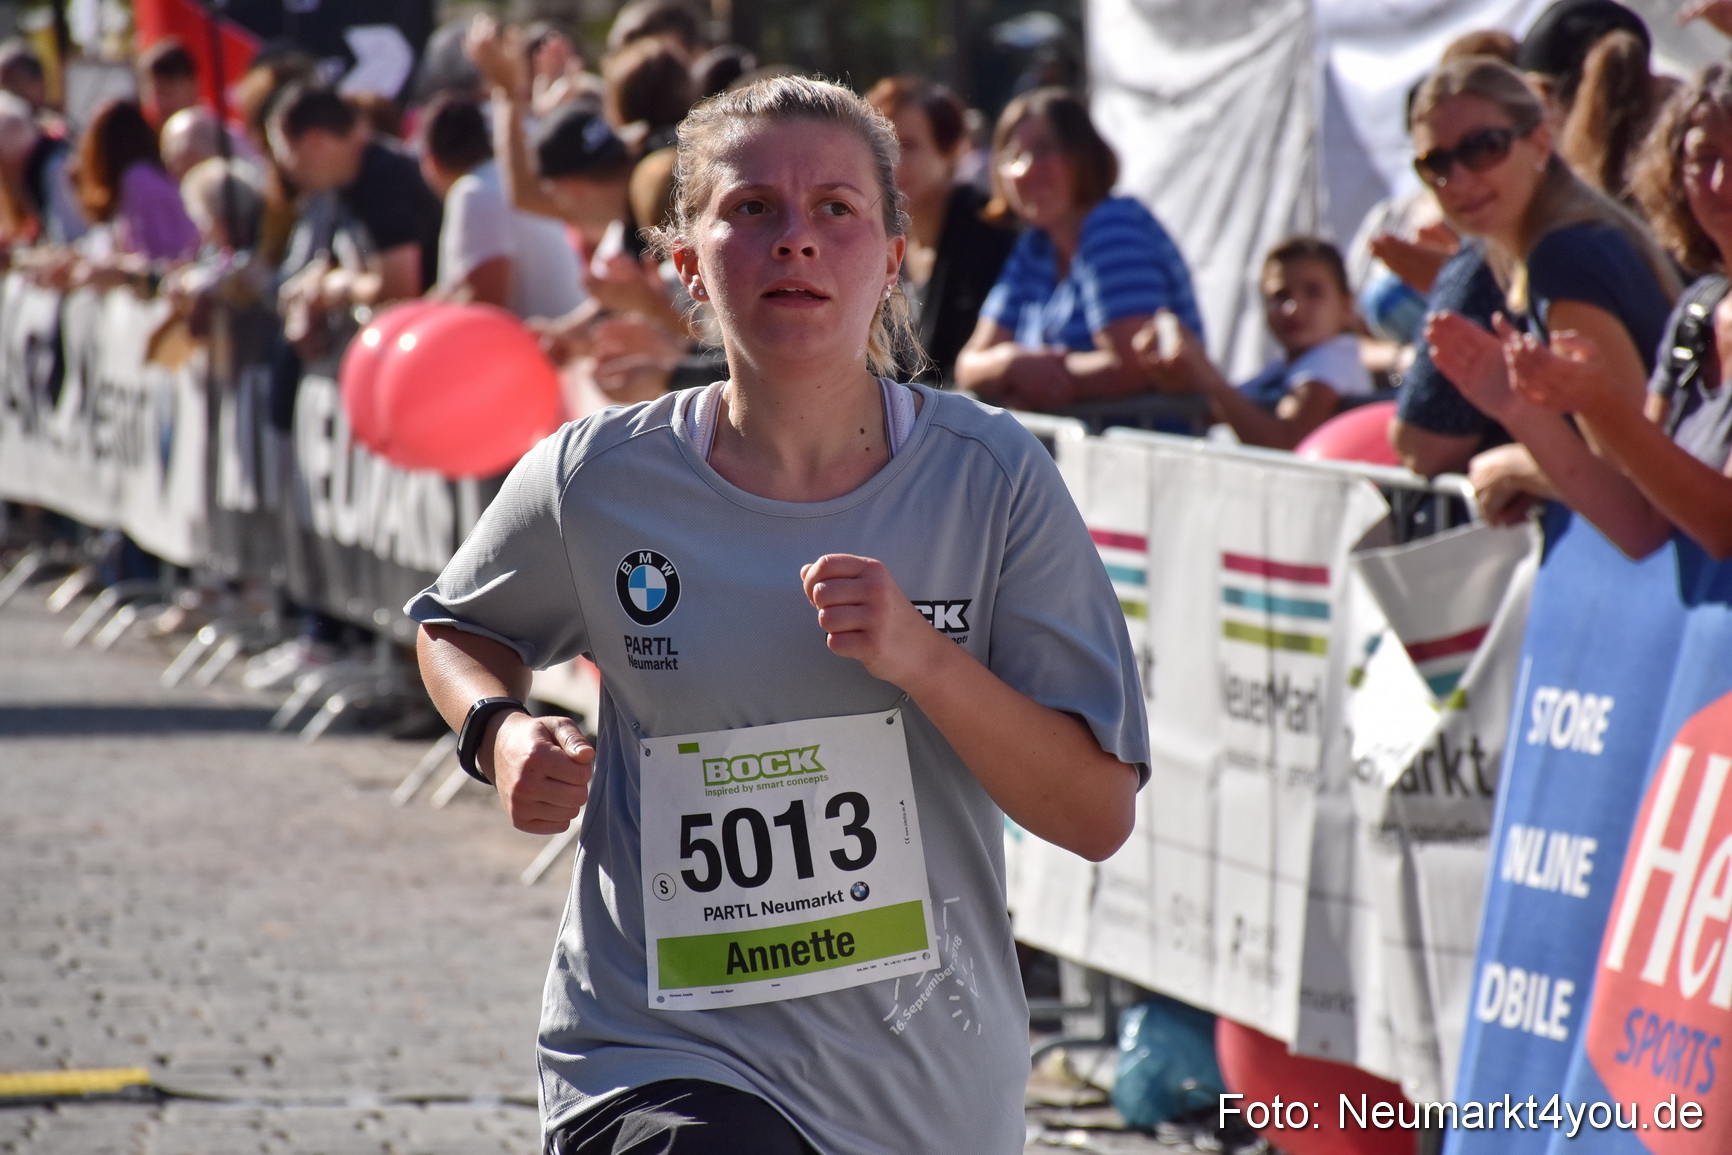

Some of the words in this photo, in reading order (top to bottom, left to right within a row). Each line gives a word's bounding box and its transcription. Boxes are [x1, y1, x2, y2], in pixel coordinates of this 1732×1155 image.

[620, 552, 675, 577] BMW
[911, 599, 972, 633] CK
[624, 634, 678, 656] PARTL
[627, 654, 679, 671] Neumarkt
[1526, 685, 1615, 756] STORE
[703, 744, 827, 787] BOCK
[704, 785, 741, 798] inspired
[742, 783, 754, 793] by
[756, 780, 784, 791] smart
[786, 774, 829, 787] concepts
[1399, 731, 1497, 798] arkt
[680, 791, 878, 893] 5013
[1501, 822, 1598, 898] NLINE
[660, 880, 668, 894] S
[703, 904, 758, 922] PARTL
[761, 889, 845, 915] Neumarkt
[726, 928, 856, 975] Annette
[890, 1019, 907, 1035] 16.
[902, 961, 956, 1021] September
[1476, 960, 1576, 1042] OBILE
[1614, 1007, 1722, 1095] SPORTS
